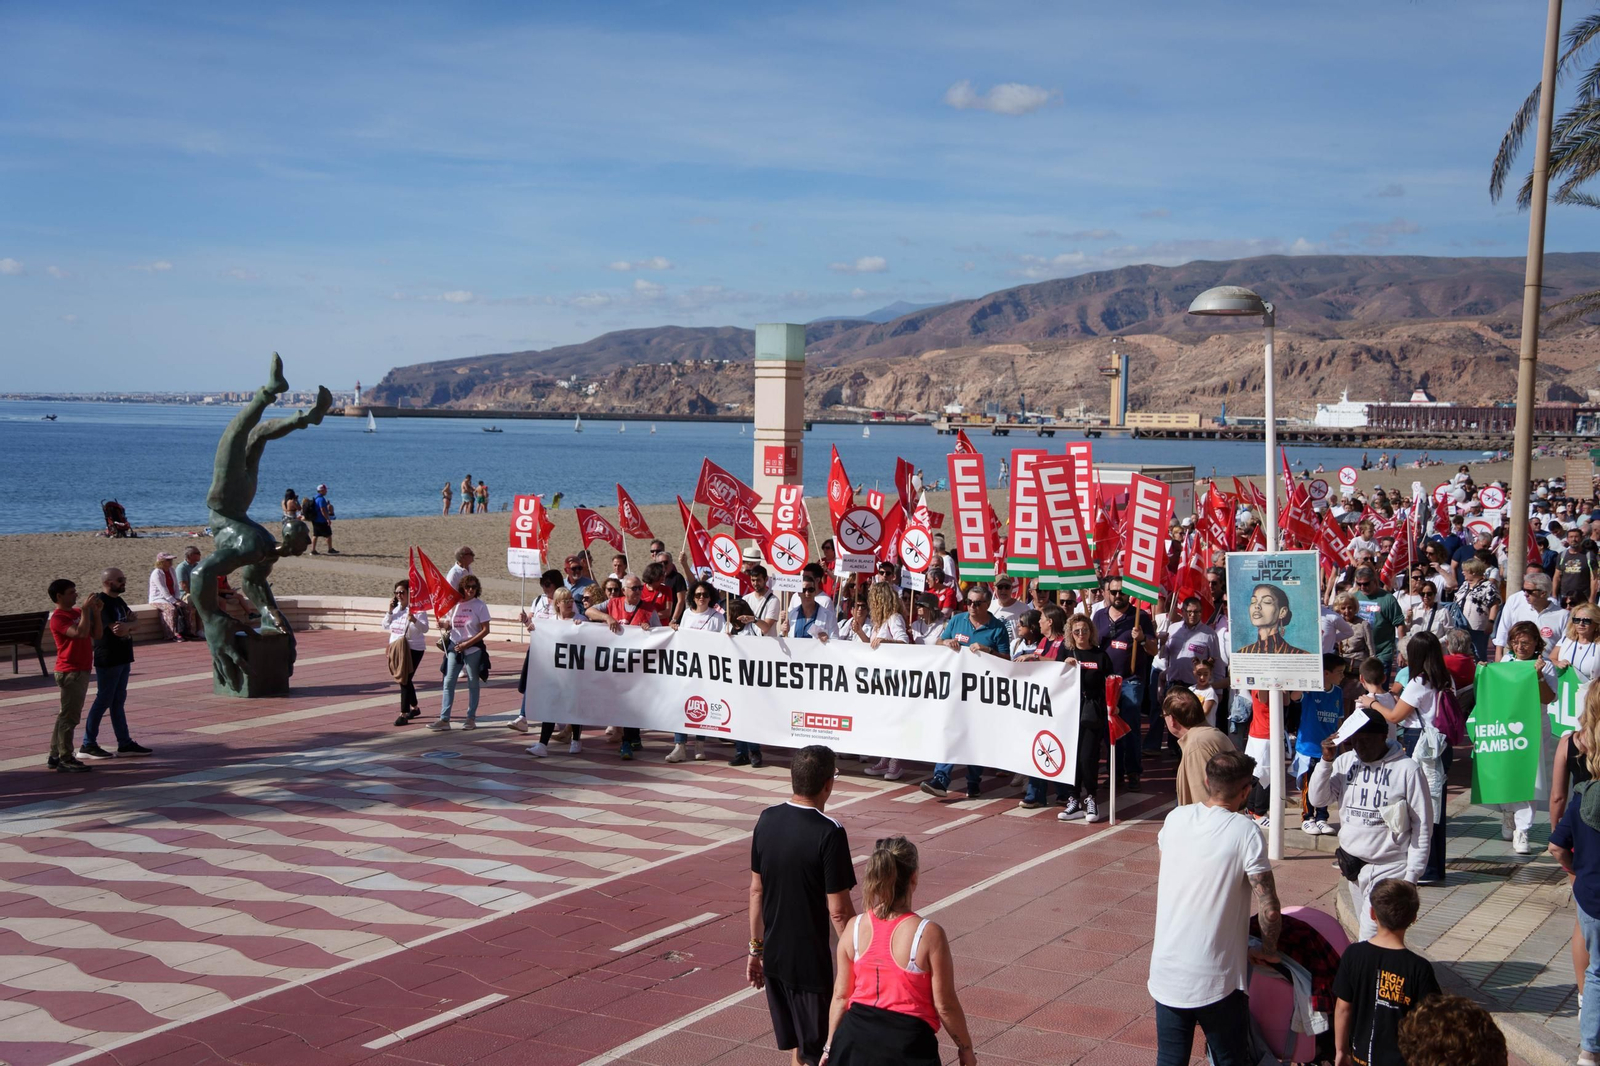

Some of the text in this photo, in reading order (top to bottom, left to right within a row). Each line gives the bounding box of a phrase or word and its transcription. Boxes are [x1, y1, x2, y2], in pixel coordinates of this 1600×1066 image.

[953, 459, 987, 559] CCOO
[1038, 466, 1087, 568] CCOO
[515, 498, 535, 548] UGT
[1129, 480, 1163, 582] CCOO
[1252, 569, 1293, 581] JAZZ
[554, 643, 1054, 717] EN DEFENSA DE NUESTRA SANIDAD PÚBLICA
[687, 699, 706, 712] UGT
[806, 715, 839, 727] CCOO
[1381, 969, 1405, 986] HIGH
[1379, 979, 1405, 995] LEVEL
[1378, 988, 1411, 1006] GAMER
